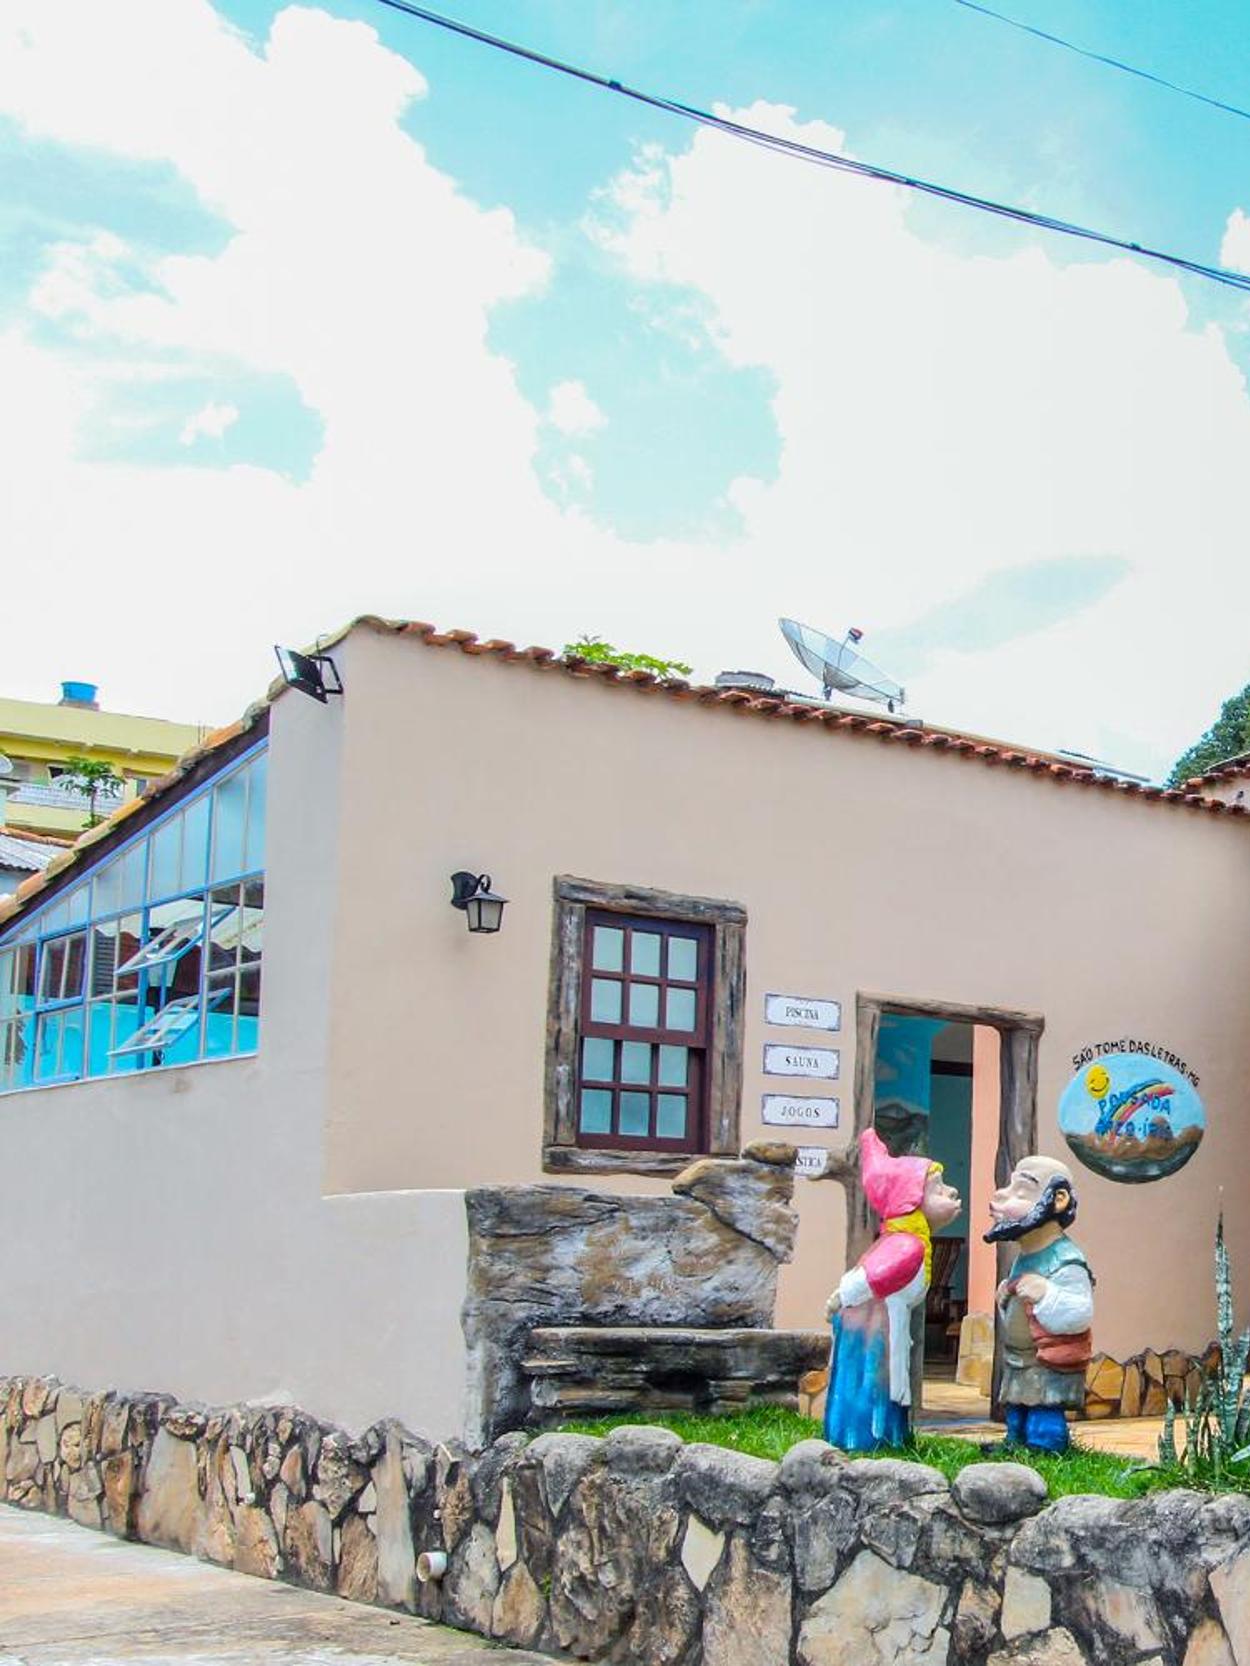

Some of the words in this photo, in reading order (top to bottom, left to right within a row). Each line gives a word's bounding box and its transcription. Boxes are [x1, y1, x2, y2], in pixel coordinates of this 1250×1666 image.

[785, 1006, 819, 1020] PISCINA
[785, 1056, 819, 1069] SAUNA
[781, 1106, 820, 1119] JOGOS
